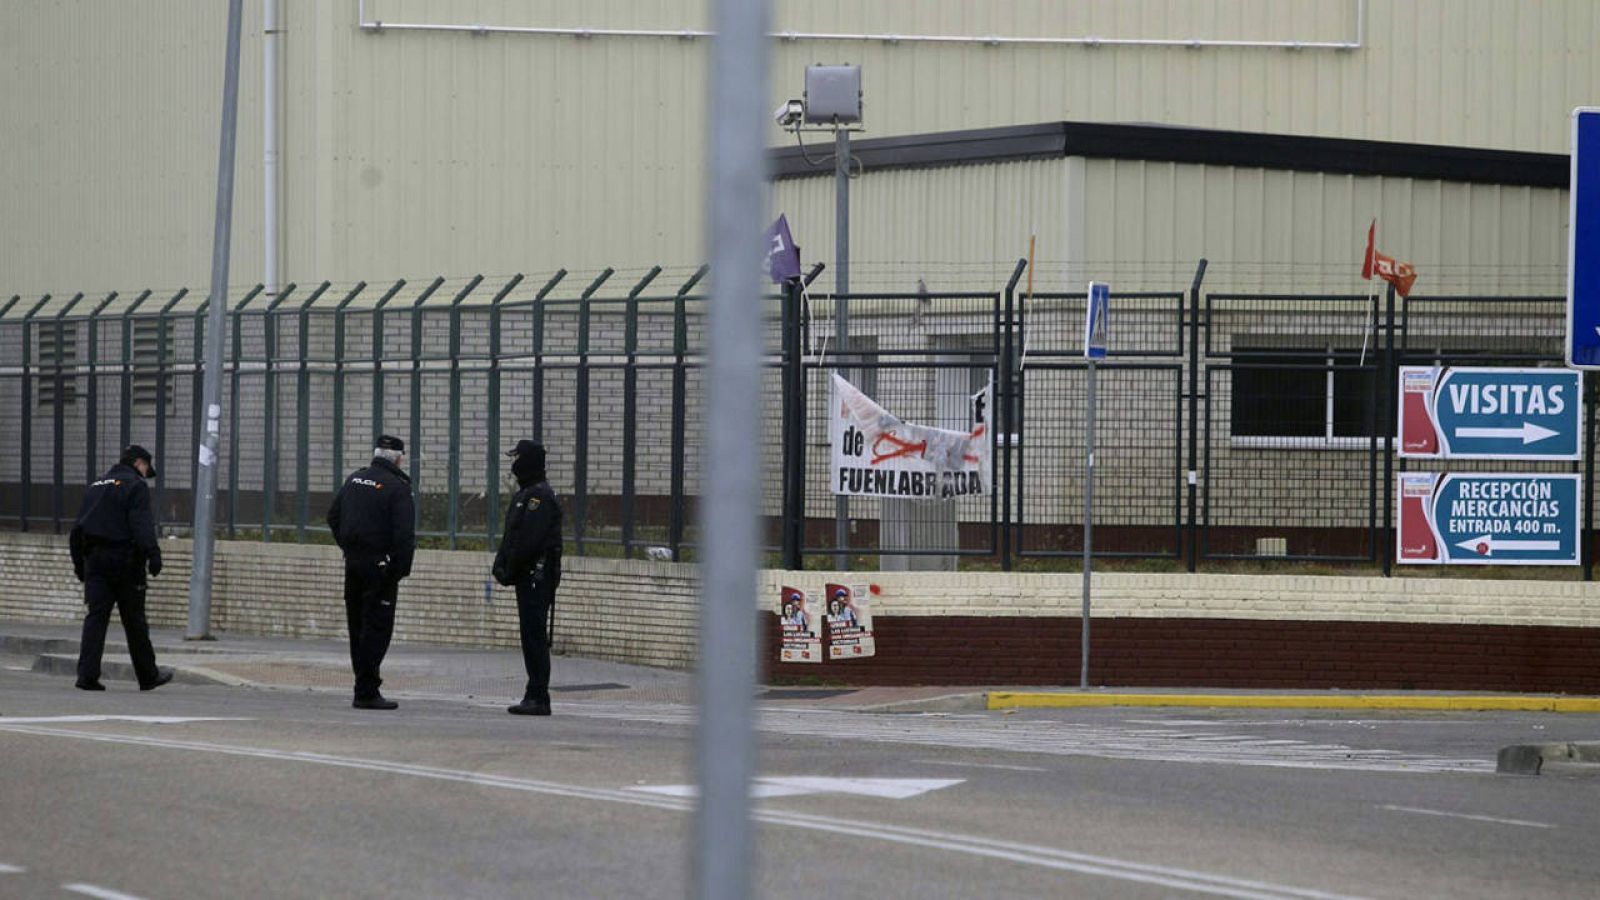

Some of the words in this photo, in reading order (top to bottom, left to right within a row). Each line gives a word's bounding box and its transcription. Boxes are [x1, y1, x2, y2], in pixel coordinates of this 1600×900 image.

[1449, 384, 1565, 415] VISITAS
[843, 425, 864, 457] de
[839, 467, 982, 498] FUENLABRADA
[1459, 479, 1552, 500] RECEPCIÓN
[1451, 498, 1560, 518] MERCANCÍAS
[1449, 519, 1511, 533] ENTRADA
[1514, 519, 1540, 533] 400
[1543, 522, 1561, 534] m.
